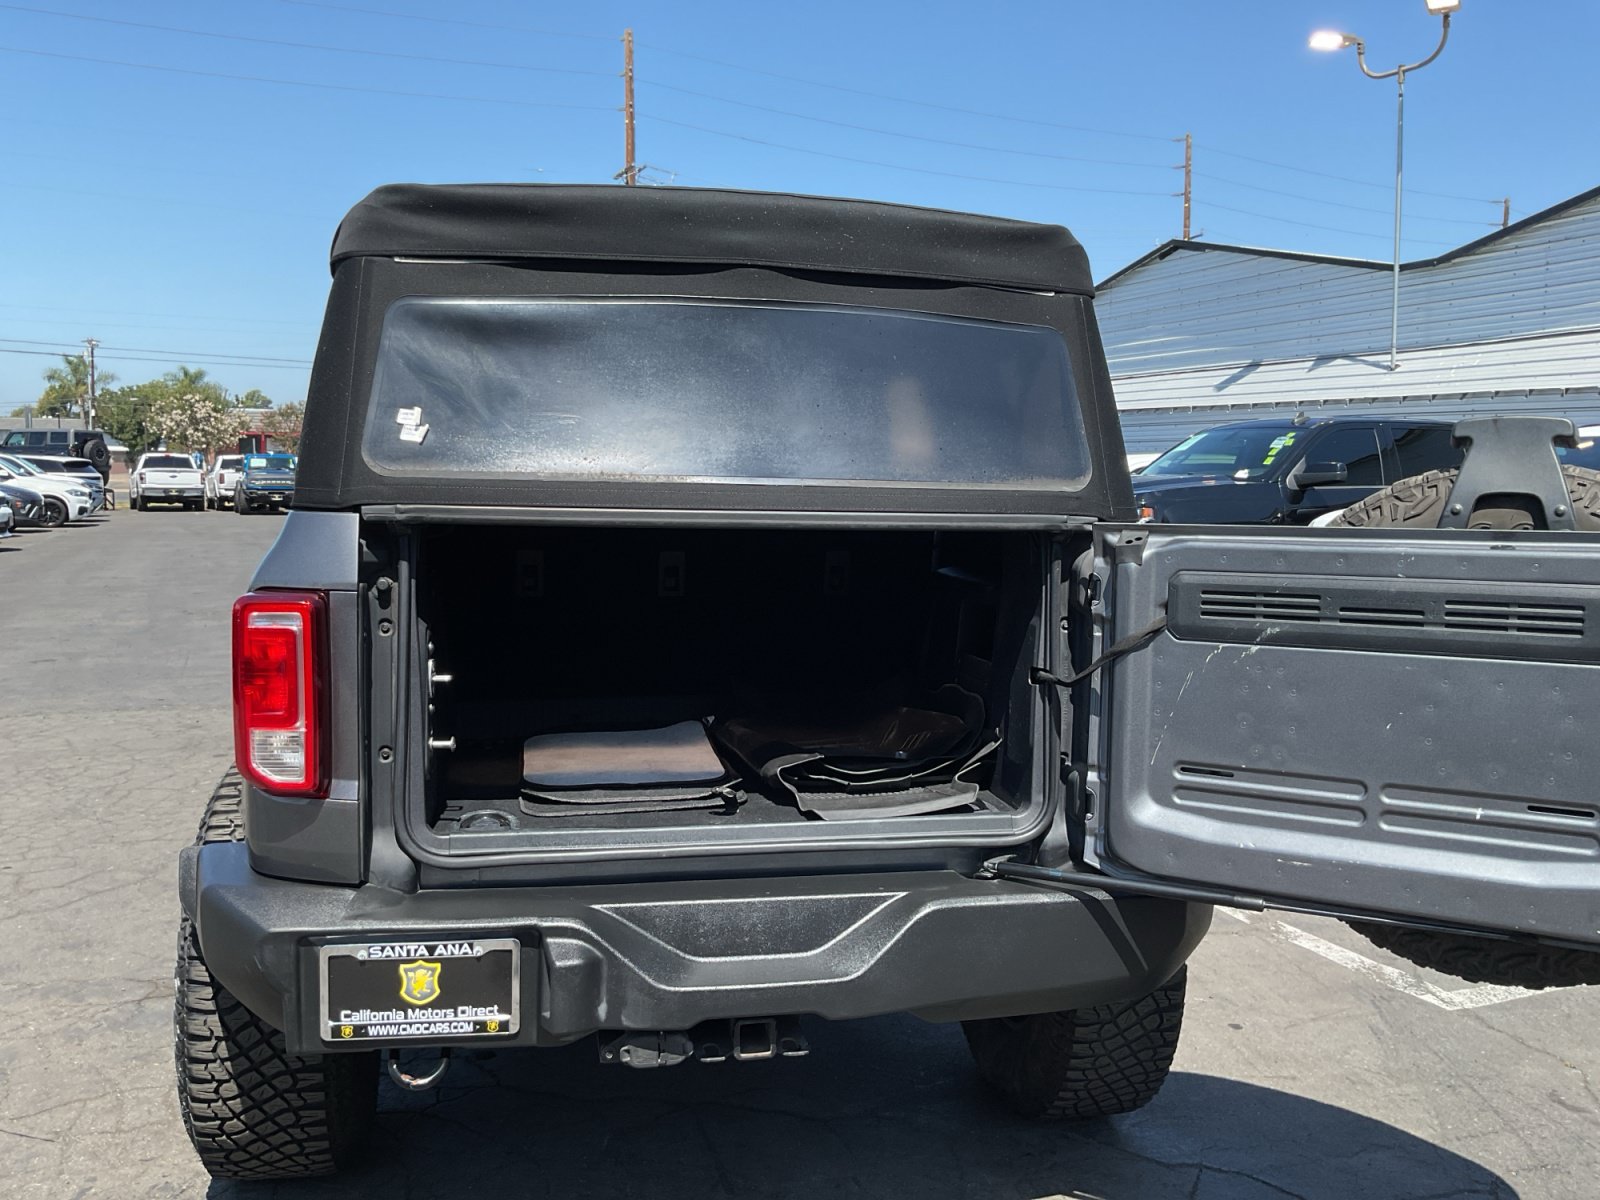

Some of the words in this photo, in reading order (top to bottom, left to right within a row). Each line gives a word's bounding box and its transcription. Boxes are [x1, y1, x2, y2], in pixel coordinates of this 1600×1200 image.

[369, 944, 428, 958] SANTA
[433, 942, 473, 955] ANA
[340, 1008, 405, 1022] California
[407, 1006, 454, 1019] Motors
[457, 1004, 500, 1016] Direct
[368, 1022, 474, 1036] WWW.CMDCARS.COM
